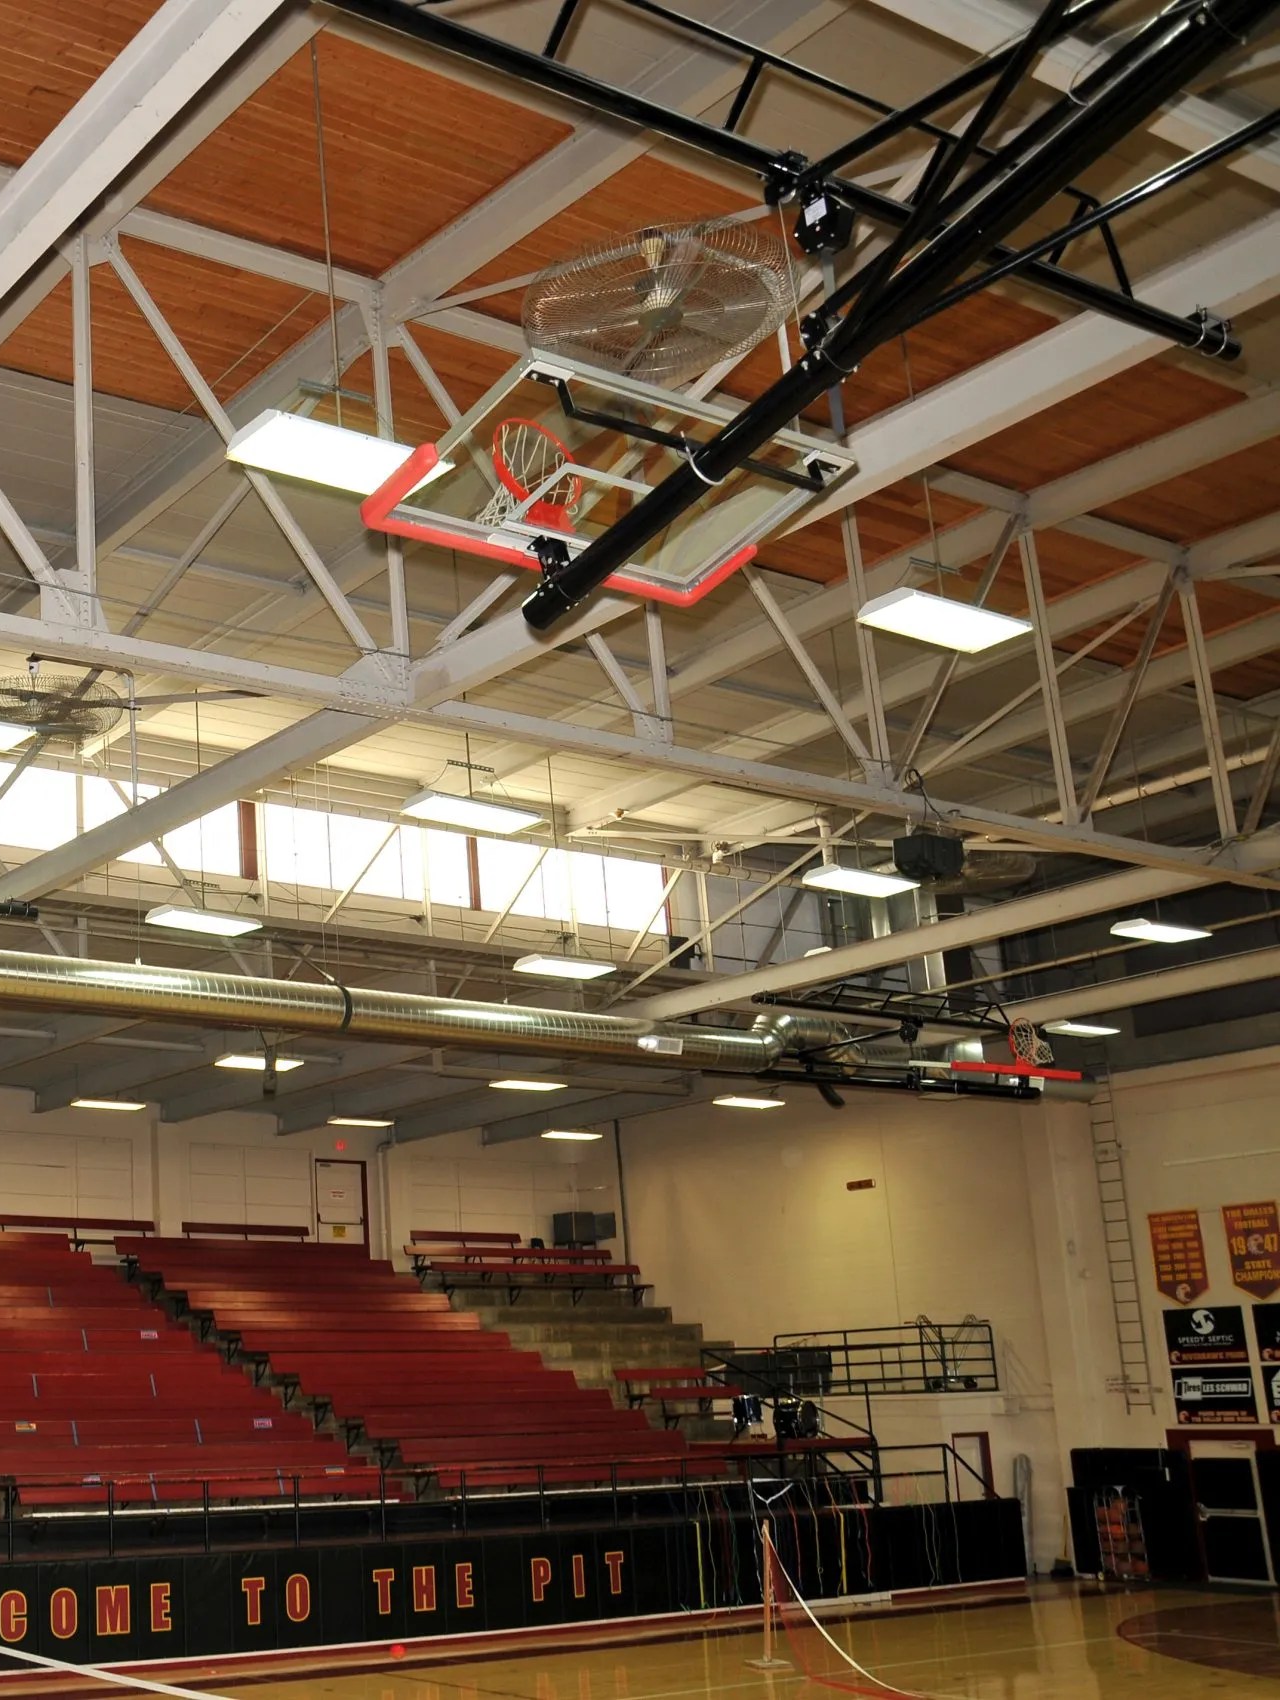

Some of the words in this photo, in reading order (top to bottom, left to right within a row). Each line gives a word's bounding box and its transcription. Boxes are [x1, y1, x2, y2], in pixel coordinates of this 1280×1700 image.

[1244, 1259, 1272, 1270] STATE
[1178, 1335, 1205, 1344] SPEEDY
[1208, 1334, 1235, 1343] SEPTIC
[241, 1573, 311, 1625] TO
[372, 1562, 475, 1615] THE
[530, 1551, 624, 1602] PIT
